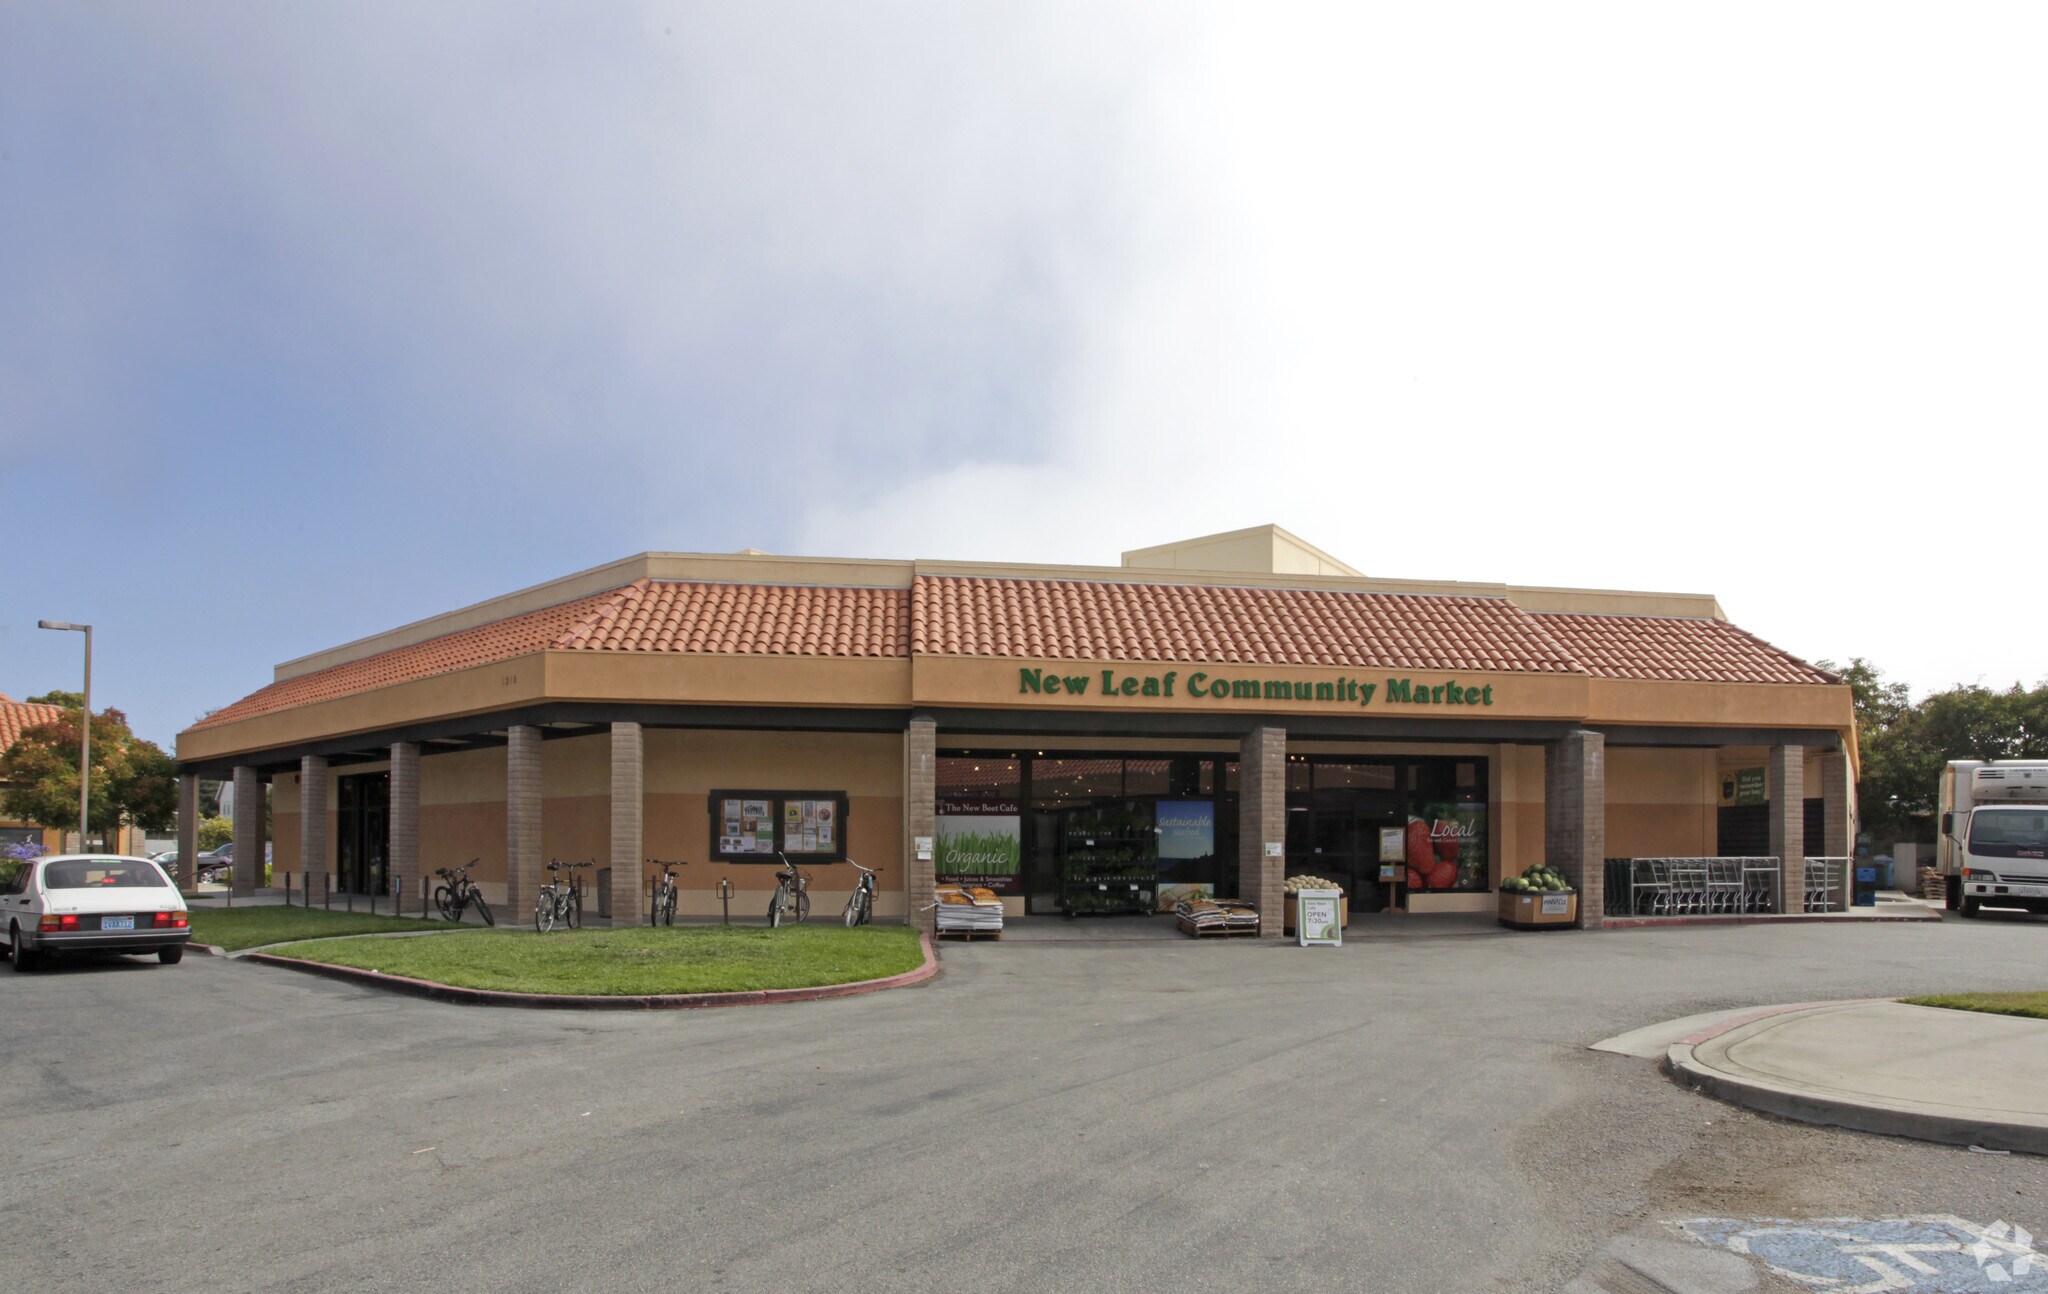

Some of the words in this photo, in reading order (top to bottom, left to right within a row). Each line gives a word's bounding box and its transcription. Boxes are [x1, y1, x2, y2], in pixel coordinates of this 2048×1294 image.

[1019, 668, 1090, 695] New
[1101, 670, 1178, 697] Leaf
[1187, 672, 1377, 706] Community
[1386, 678, 1494, 706] Market
[945, 803, 960, 812] The
[962, 803, 980, 812] New
[982, 803, 998, 812] Beet
[999, 803, 1018, 812] Cafe
[1430, 818, 1475, 837] Local
[946, 849, 1008, 872] Organic
